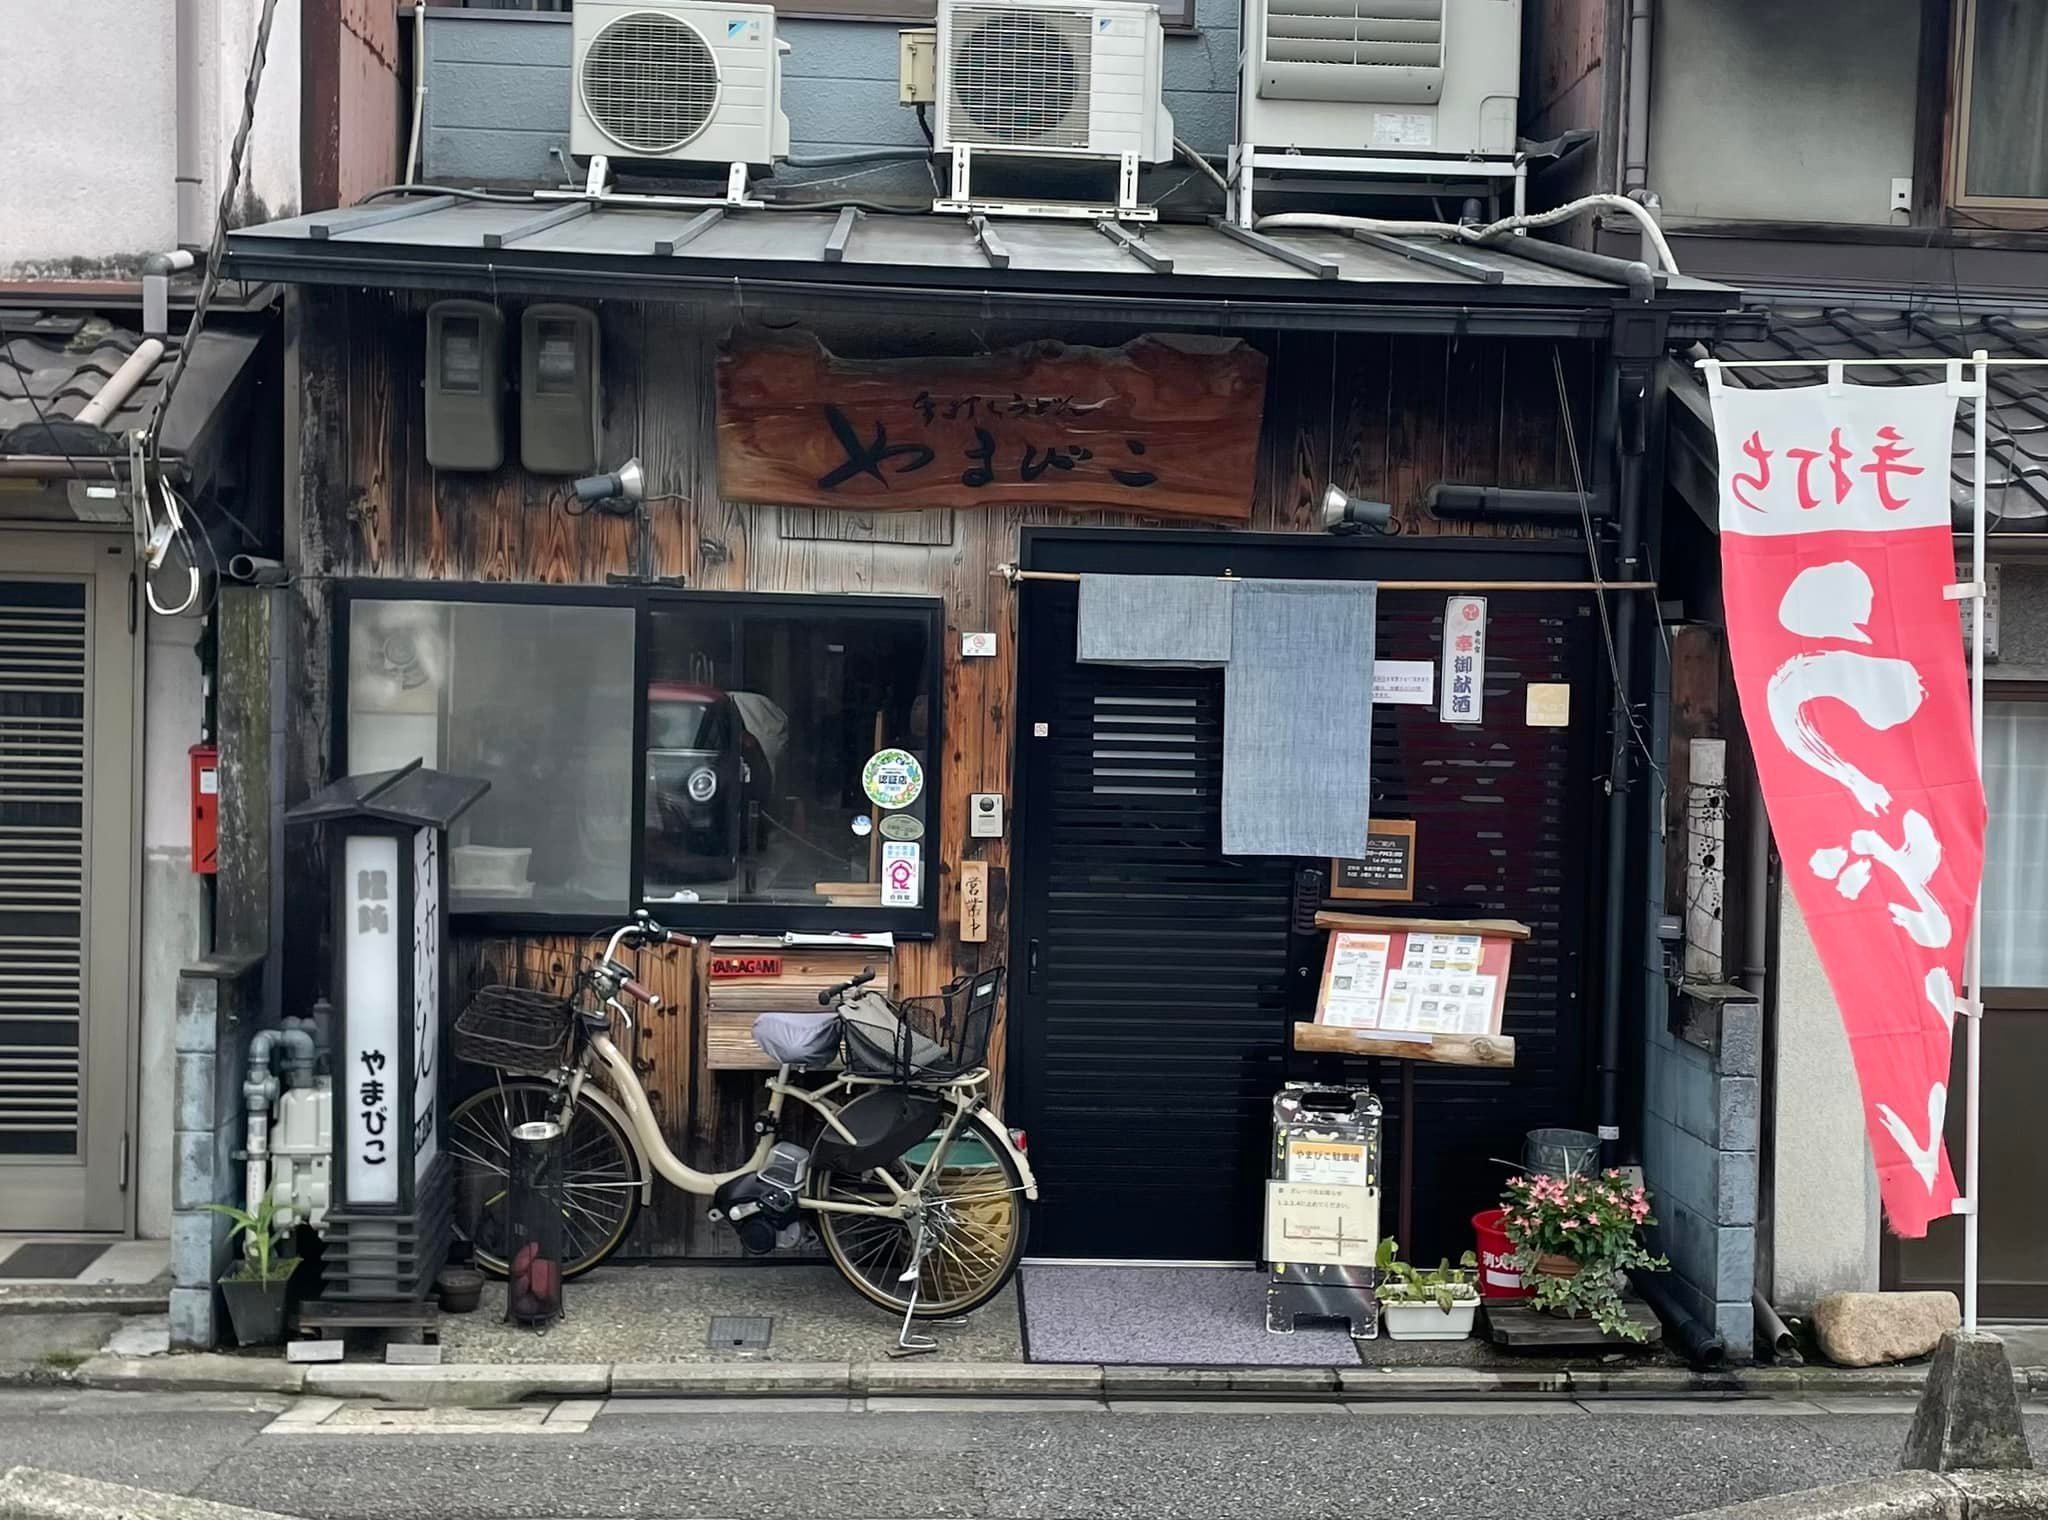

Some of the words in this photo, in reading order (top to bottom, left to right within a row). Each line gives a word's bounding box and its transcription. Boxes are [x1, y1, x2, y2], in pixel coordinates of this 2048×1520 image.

[817, 404, 1158, 490] やまびこ
[965, 876, 984, 937] 営業中
[360, 1050, 388, 1165] やまびこ
